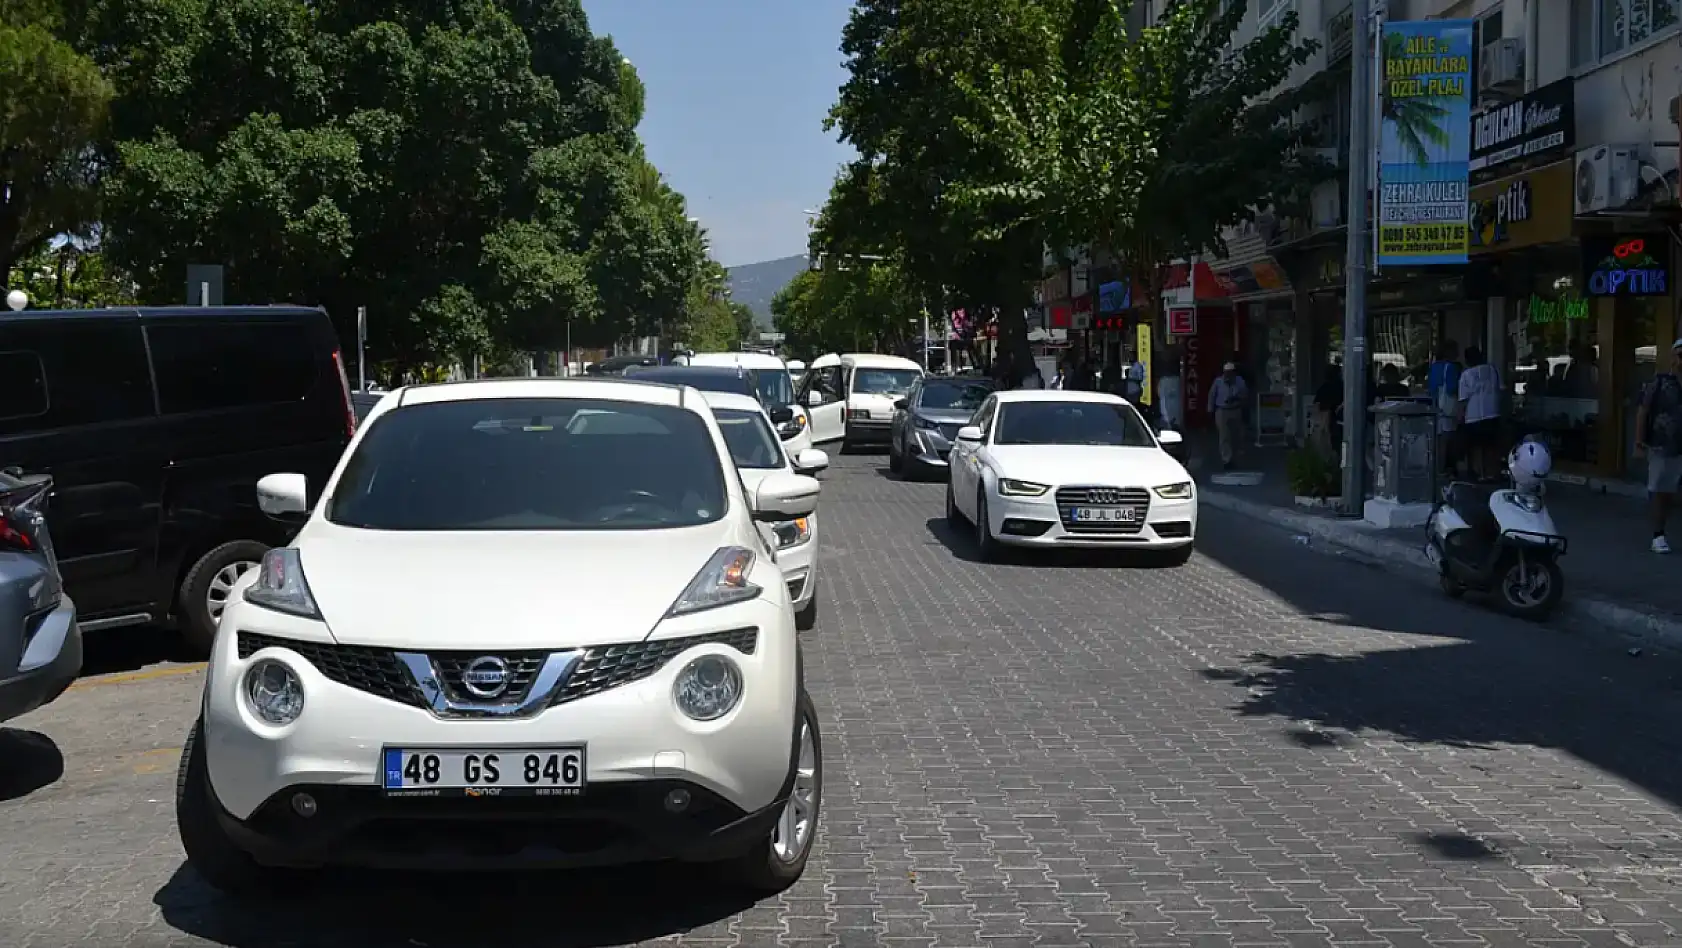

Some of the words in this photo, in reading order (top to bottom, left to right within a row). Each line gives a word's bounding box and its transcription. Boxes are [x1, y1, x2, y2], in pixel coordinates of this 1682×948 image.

[1385, 56, 1468, 77] BAYANLARA
[1428, 77, 1463, 96] PLAJ
[1384, 182, 1423, 203] ZEHRA
[1077, 509, 1091, 519] 48
[1096, 510, 1110, 520] JL
[1115, 509, 1135, 520] 048
[466, 672, 505, 683] NISSAN
[387, 770, 401, 781] TR
[404, 754, 440, 784] 48
[464, 754, 500, 784] GS
[523, 754, 579, 784] 846
